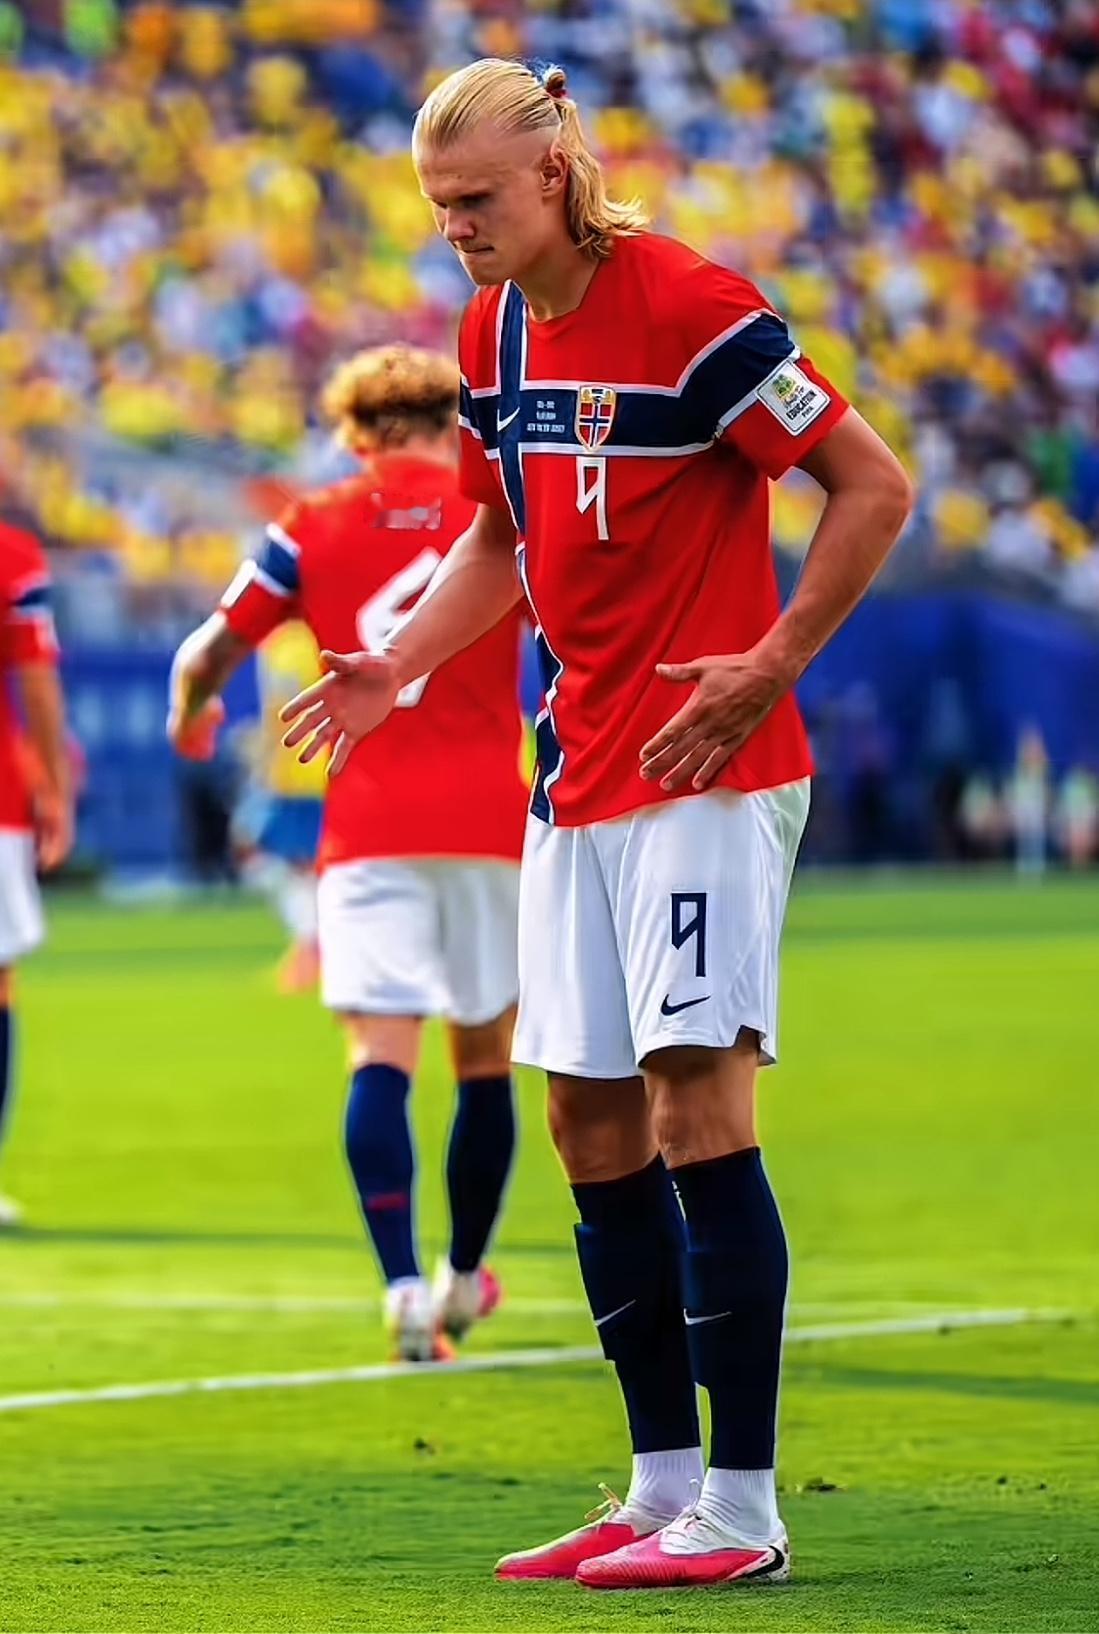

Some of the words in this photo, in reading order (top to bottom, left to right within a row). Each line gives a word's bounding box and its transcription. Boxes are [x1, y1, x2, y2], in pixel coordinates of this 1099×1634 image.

[786, 389, 817, 420] EDUCATION
[576, 456, 609, 540] 9
[671, 892, 707, 978] 9
